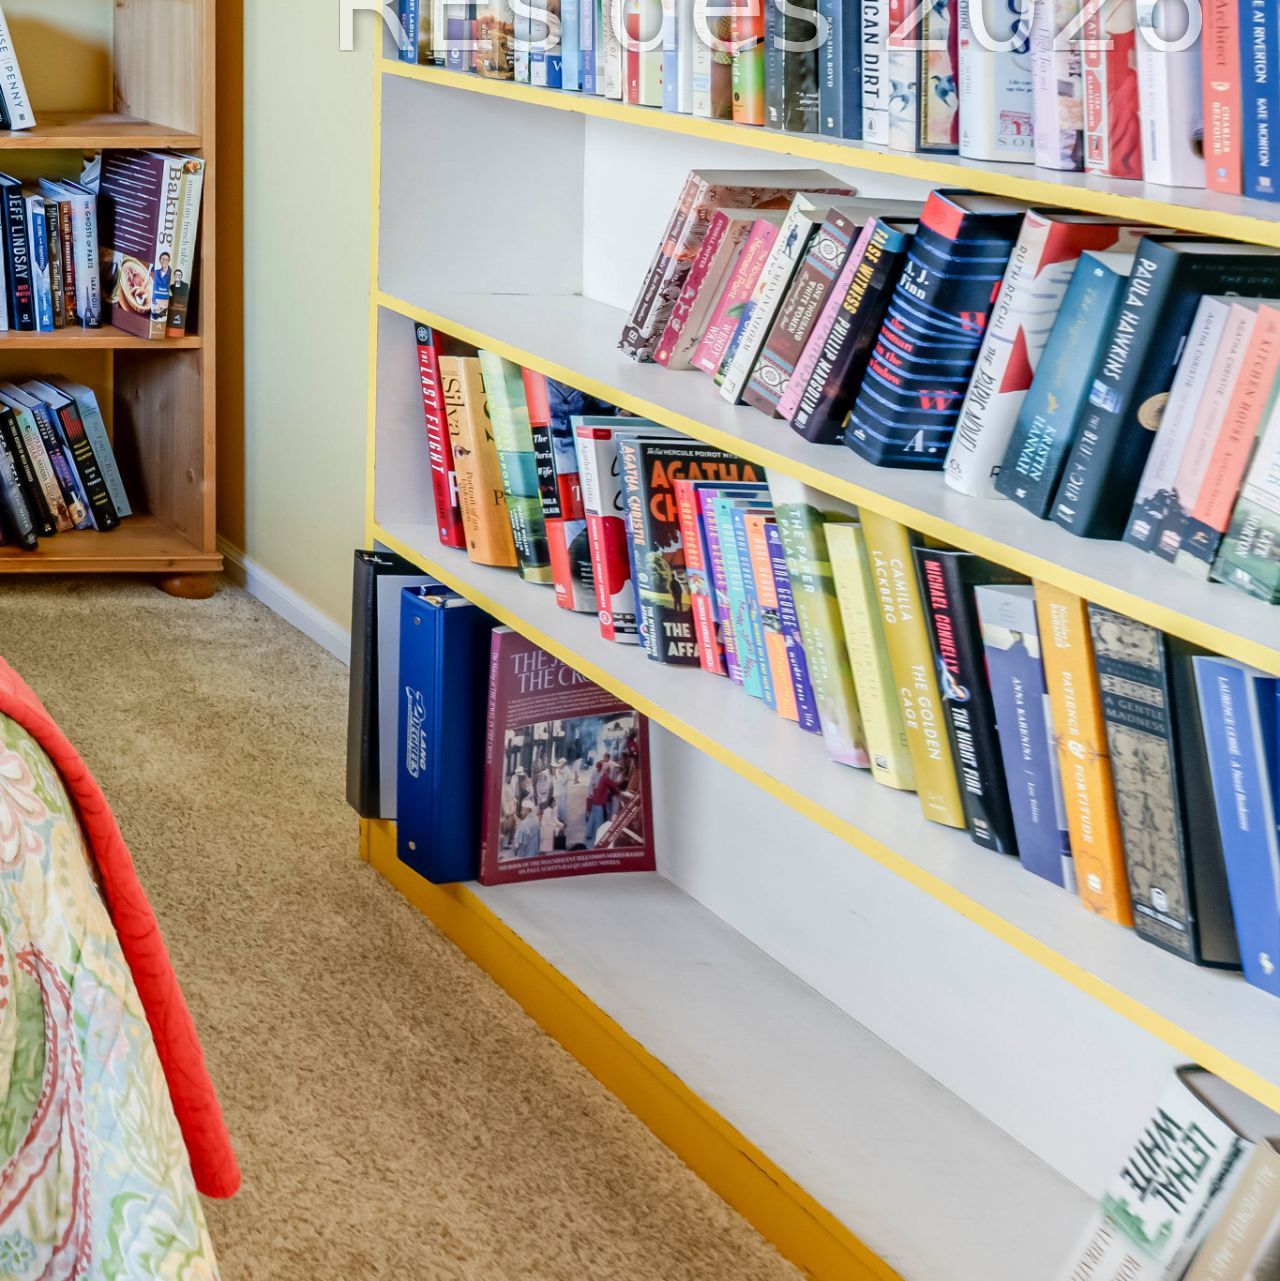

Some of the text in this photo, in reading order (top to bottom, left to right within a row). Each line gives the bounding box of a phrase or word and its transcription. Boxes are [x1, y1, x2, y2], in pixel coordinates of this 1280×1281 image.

[4, 66, 24, 108] PENNY
[864, 53, 881, 99] DIRT
[158, 165, 182, 248] Baking
[8, 194, 29, 279] JEFF LINDSAY
[843, 228, 889, 315] FALSE WITNESS
[1008, 246, 1028, 281] RUTH
[899, 277, 927, 300] Finn
[703, 324, 721, 351] WAX
[1102, 257, 1158, 382] PAULA HAWKINS
[420, 365, 437, 408] LAST
[442, 377, 464, 437] Silva
[426, 414, 445, 474] FLIGHT
[533, 433, 548, 443] The
[1016, 415, 1046, 473] HANNAH
[1033, 425, 1057, 481] KRISTIN
[623, 445, 645, 546] AGATHA CHRISTIE
[790, 510, 815, 593] THE PAPER
[1235, 512, 1260, 558] MORTON
[1252, 531, 1275, 558] KATE
[891, 558, 913, 622] CAMILLA
[663, 622, 692, 638] THE
[925, 560, 960, 674] MICHAEL CONNELLY
[511, 650, 547, 674] THE
[518, 668, 554, 694] THE
[900, 688, 918, 730] CAGE
[911, 664, 941, 761] THE GOLDEN
[1012, 677, 1024, 708] ANNA
[1104, 696, 1165, 720] A GENTLE
[1106, 707, 1166, 734] MADNESS
[951, 707, 983, 797] THE NIGHT FIRE
[1062, 671, 1080, 737] PATIENCE
[1074, 765, 1093, 844] FORTITUDE
